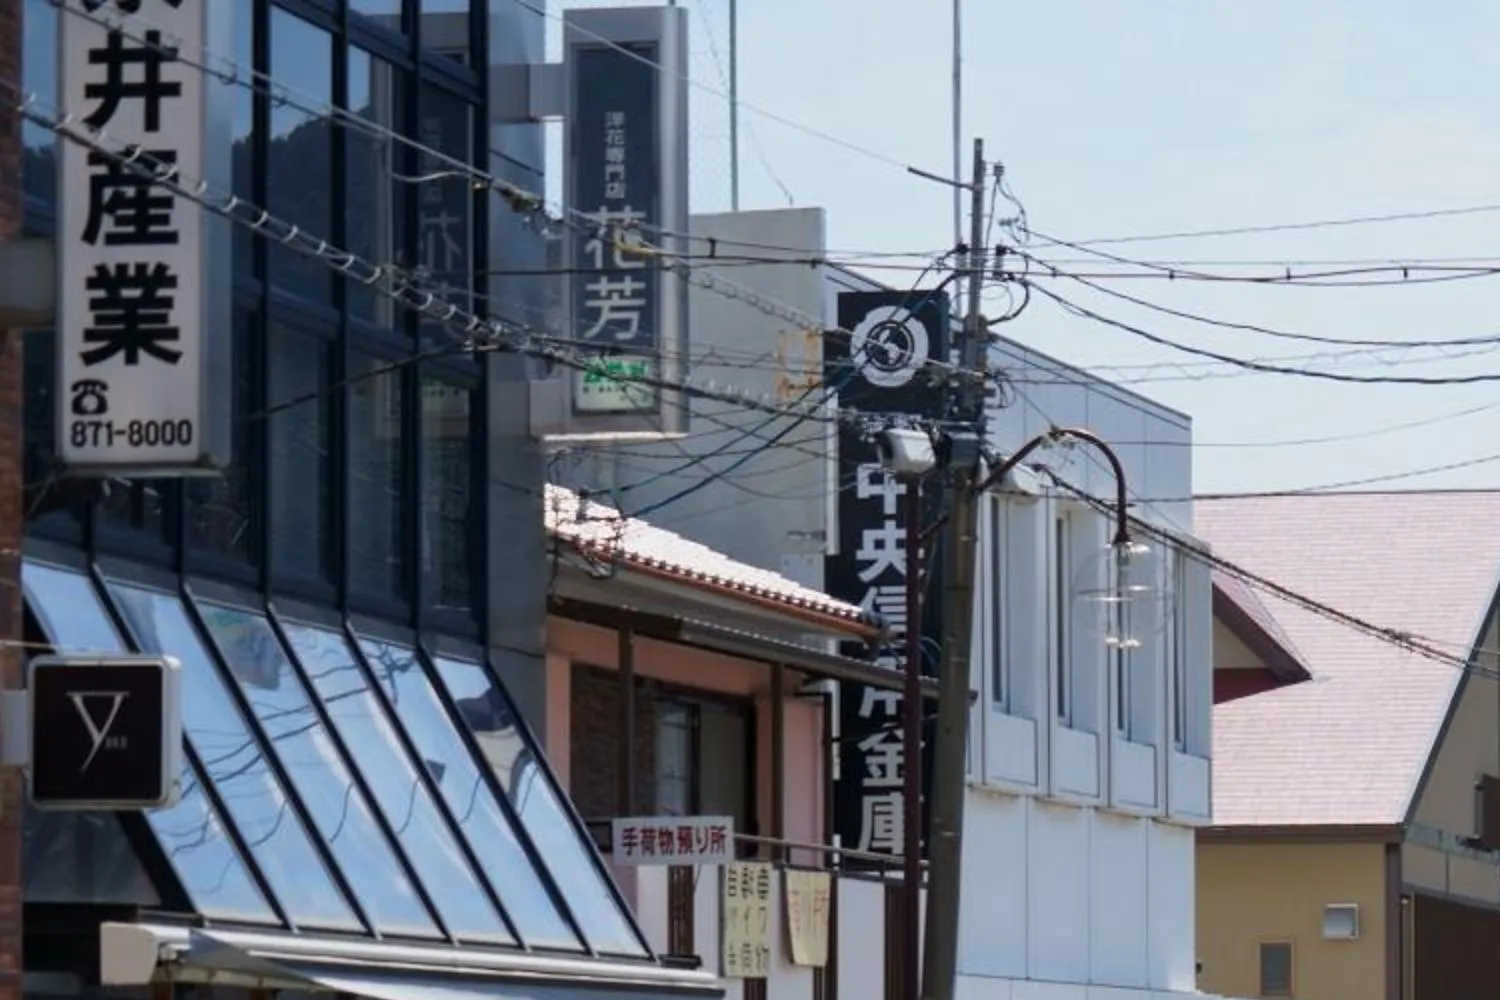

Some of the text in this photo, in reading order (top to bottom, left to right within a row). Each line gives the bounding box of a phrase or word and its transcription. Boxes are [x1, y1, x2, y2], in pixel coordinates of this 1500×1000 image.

[79, 0, 184, 366] 井産業
[583, 204, 647, 341] 花芳
[70, 419, 192, 448] 871-8000
[622, 825, 727, 857] 手荷物預り所
